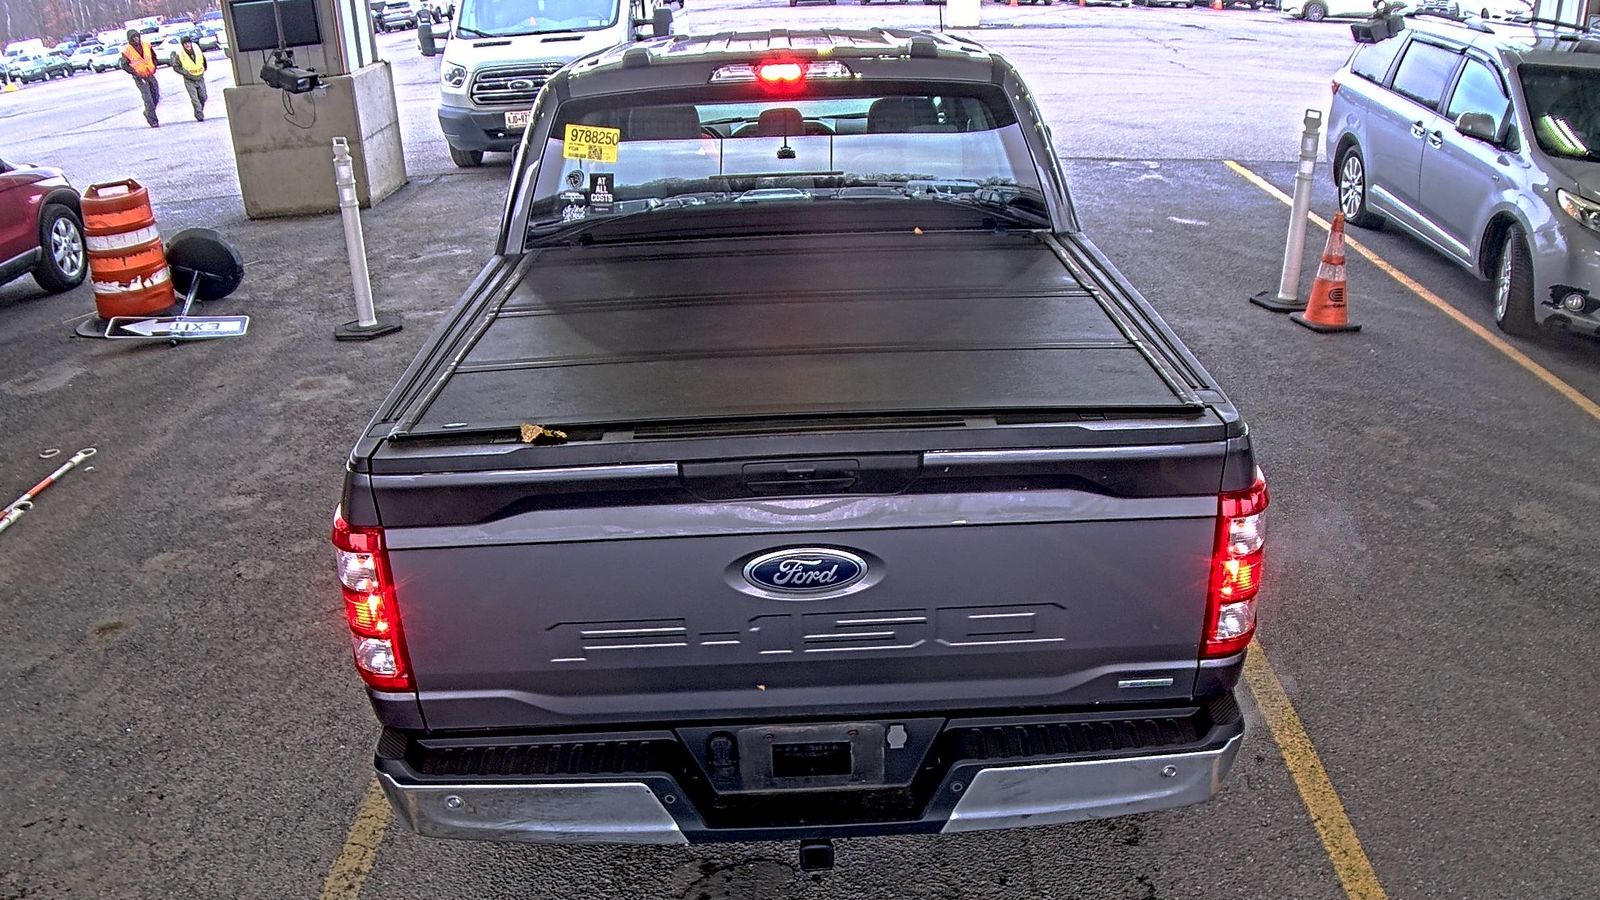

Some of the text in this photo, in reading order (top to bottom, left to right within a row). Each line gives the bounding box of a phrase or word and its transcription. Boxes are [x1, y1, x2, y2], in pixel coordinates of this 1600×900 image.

[570, 128, 619, 146] 9788250
[597, 176, 607, 186] AT
[595, 185, 609, 194] ALL
[590, 193, 613, 202] COSTS
[169, 322, 220, 331] EXIT
[772, 559, 839, 585] Ford
[546, 603, 1067, 663] F-150
